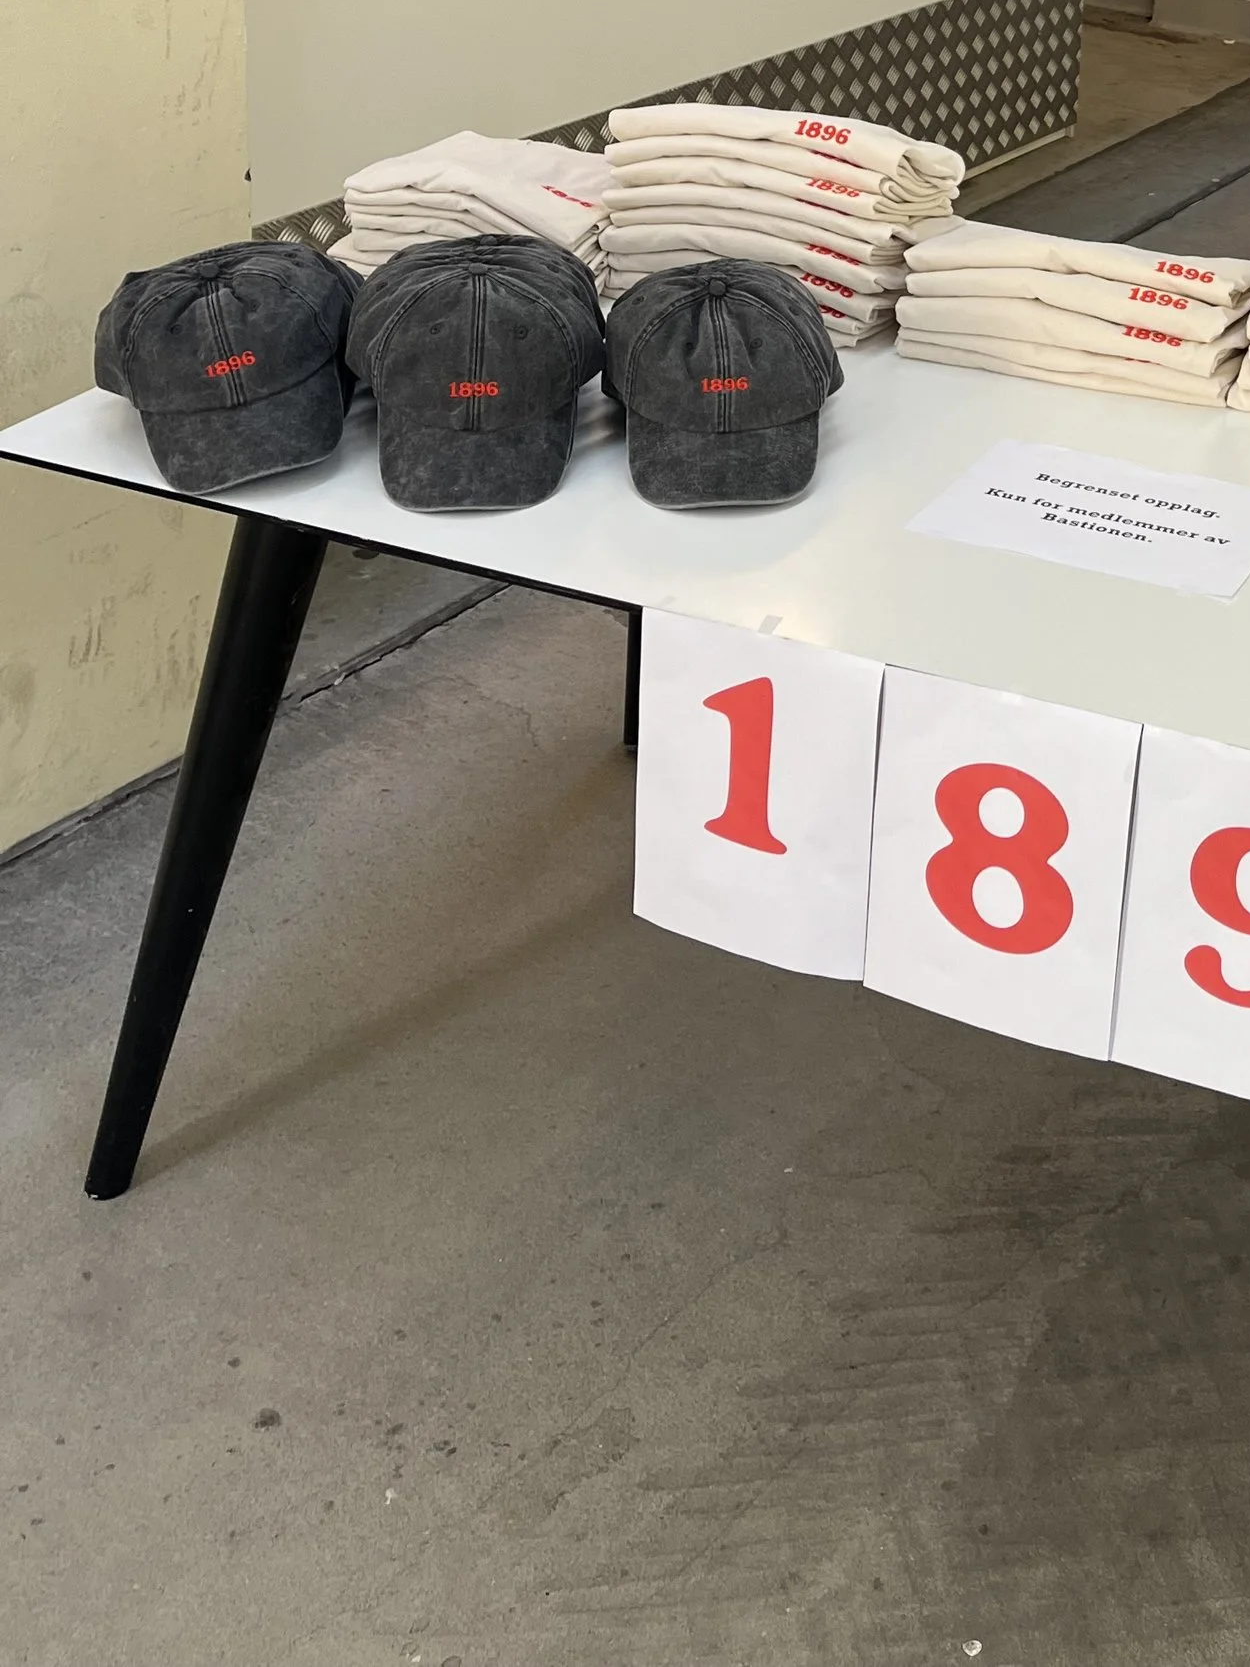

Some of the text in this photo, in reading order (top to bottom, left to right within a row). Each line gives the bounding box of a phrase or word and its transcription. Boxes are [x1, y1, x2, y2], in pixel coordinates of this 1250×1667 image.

[795, 119, 851, 145] 1896
[1155, 260, 1215, 284] 1896
[1128, 287, 1189, 310] 1896
[1122, 325, 1184, 348] 1896
[205, 350, 257, 378] 1896
[449, 381, 499, 399] 1896
[701, 377, 749, 394] 1896
[1034, 473, 1221, 519] Begrenset opplag.
[984, 487, 1231, 545] Kun for medlemmer av
[1040, 512, 1153, 543] Bastionen.
